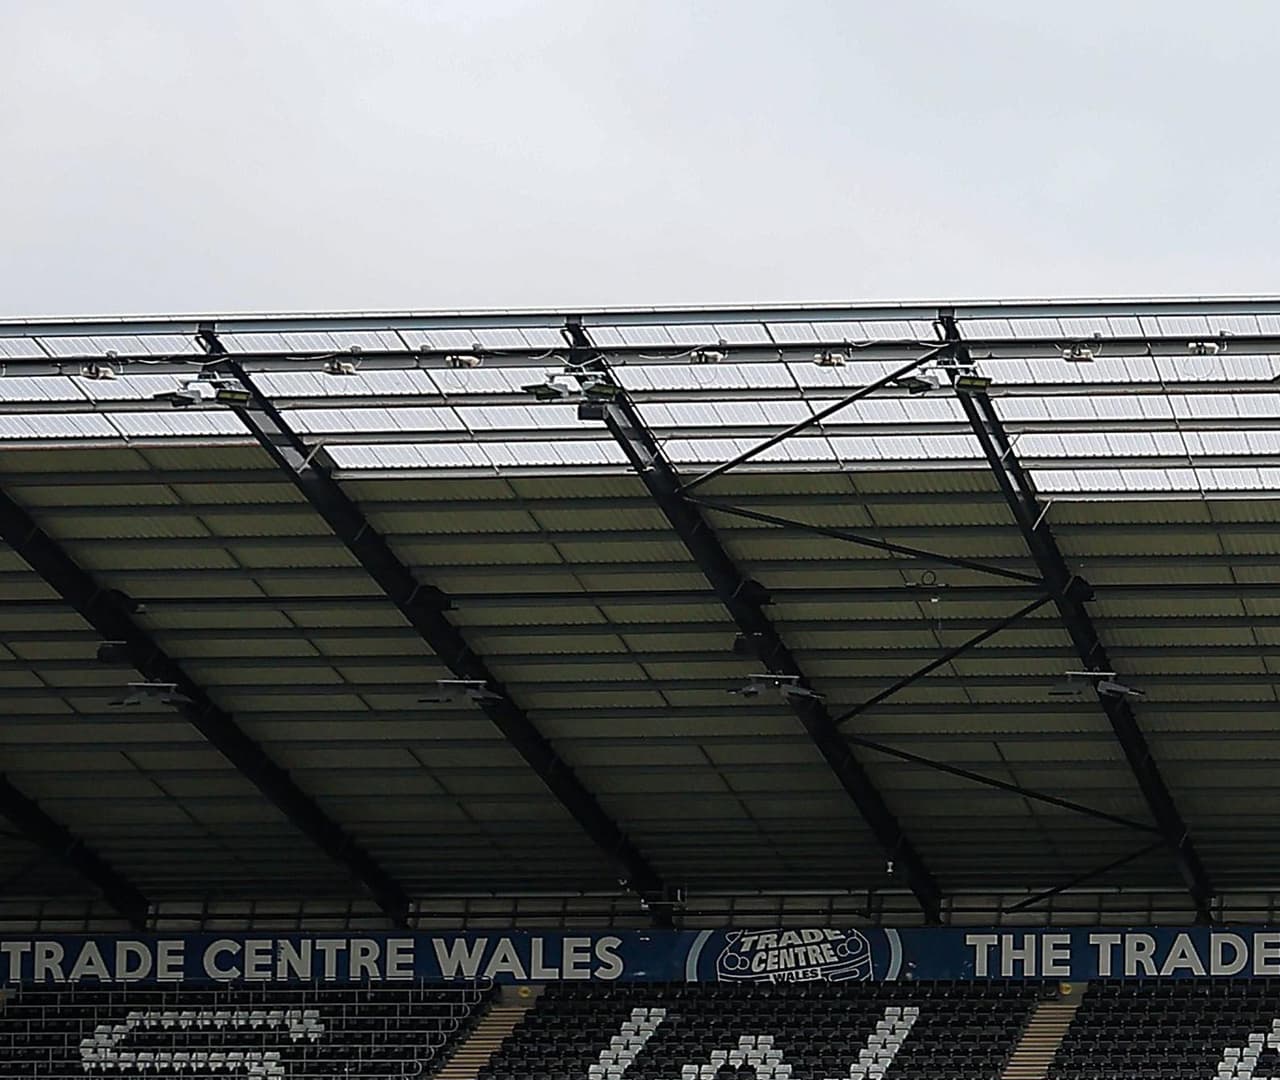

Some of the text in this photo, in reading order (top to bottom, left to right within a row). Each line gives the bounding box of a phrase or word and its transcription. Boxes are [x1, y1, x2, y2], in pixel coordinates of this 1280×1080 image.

[1, 937, 623, 980] TRADE CENTRE WALES
[740, 929, 846, 952] TRADE
[751, 943, 839, 973] CENTRE
[966, 933, 1070, 977] THE
